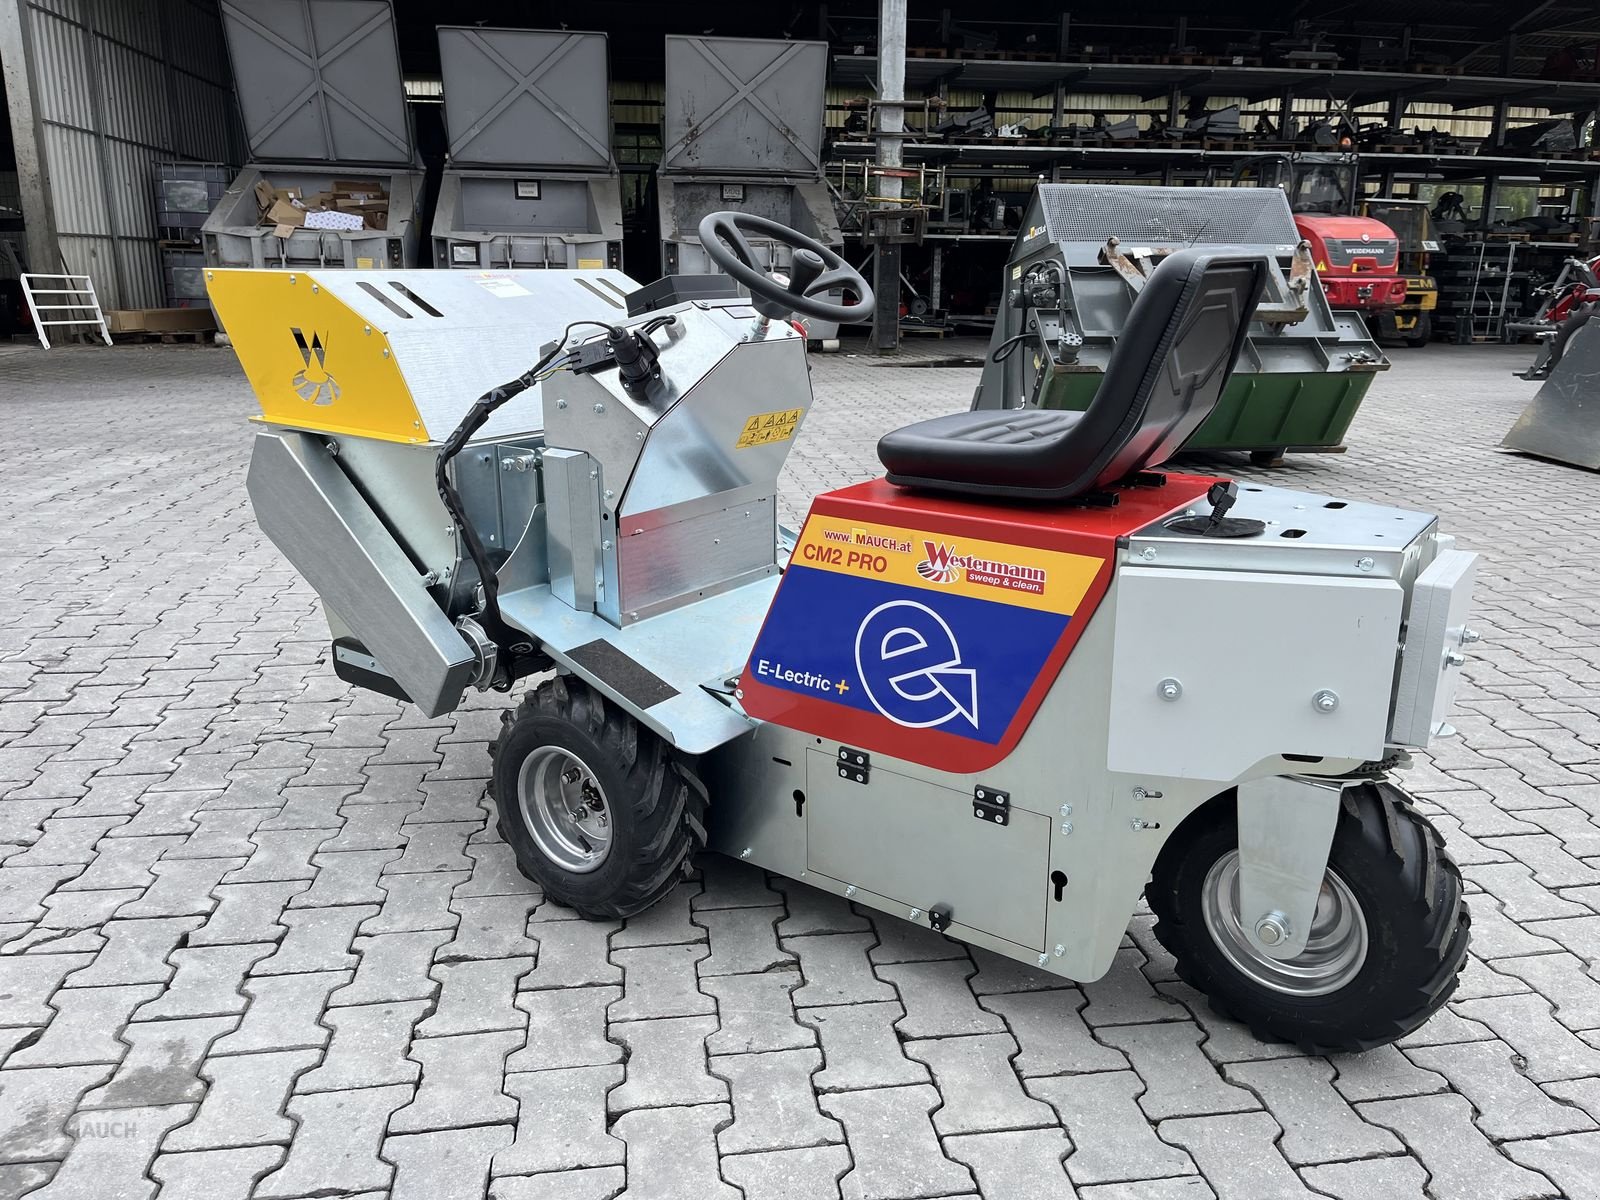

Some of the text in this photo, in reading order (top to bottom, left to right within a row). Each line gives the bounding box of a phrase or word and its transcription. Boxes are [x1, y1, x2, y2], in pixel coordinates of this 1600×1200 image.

[803, 543, 888, 573] CM2 PRO
[923, 541, 1046, 581] Westermann
[968, 573, 1042, 592] sweep & clean.
[757, 659, 831, 691] E-Lectric
